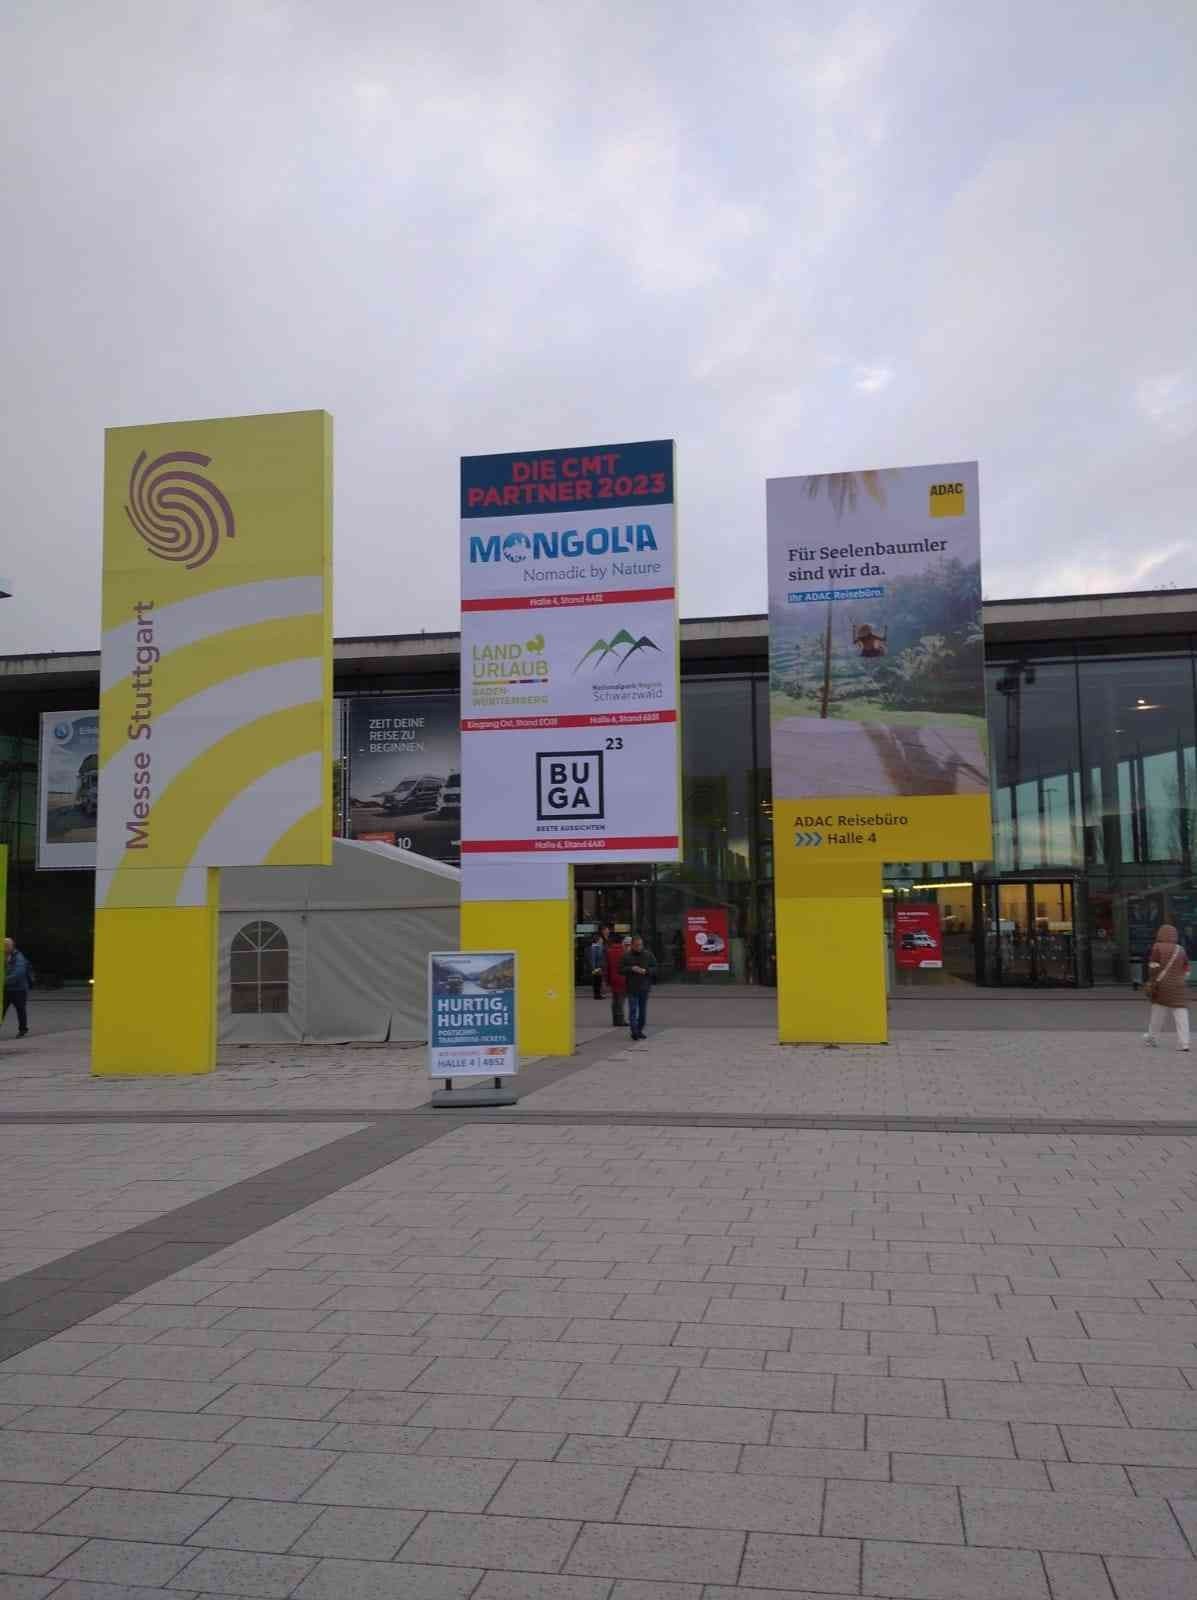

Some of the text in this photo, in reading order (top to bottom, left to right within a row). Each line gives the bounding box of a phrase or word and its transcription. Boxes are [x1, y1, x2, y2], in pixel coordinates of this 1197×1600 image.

[512, 453, 619, 481] DIE CMT
[468, 473, 666, 507] PARTNER 2023
[930, 483, 964, 496] ADAC
[469, 523, 658, 563] MONGOLIA
[788, 548, 816, 562] Für
[523, 561, 662, 582] Nomadic by Nature
[788, 563, 886, 581] sind wir da.
[805, 591, 833, 601] ADAC
[472, 644, 522, 660] LAND
[472, 660, 549, 678] URLAUB
[592, 689, 664, 702] Schwarzwald
[126, 600, 160, 850] Messe Stuttgart
[368, 717, 425, 729] ZEIT DEINE
[369, 730, 416, 741] REISE ZU
[605, 738, 624, 750] 23
[550, 762, 590, 785] BU
[548, 786, 591, 809] GA
[794, 813, 908, 827] ADAC Reisebüro
[828, 832, 877, 845] Halle 4
[438, 998, 507, 1012] HURTIG,
[438, 1013, 509, 1027] HURTIG!
[438, 1058, 467, 1068] HALLE
